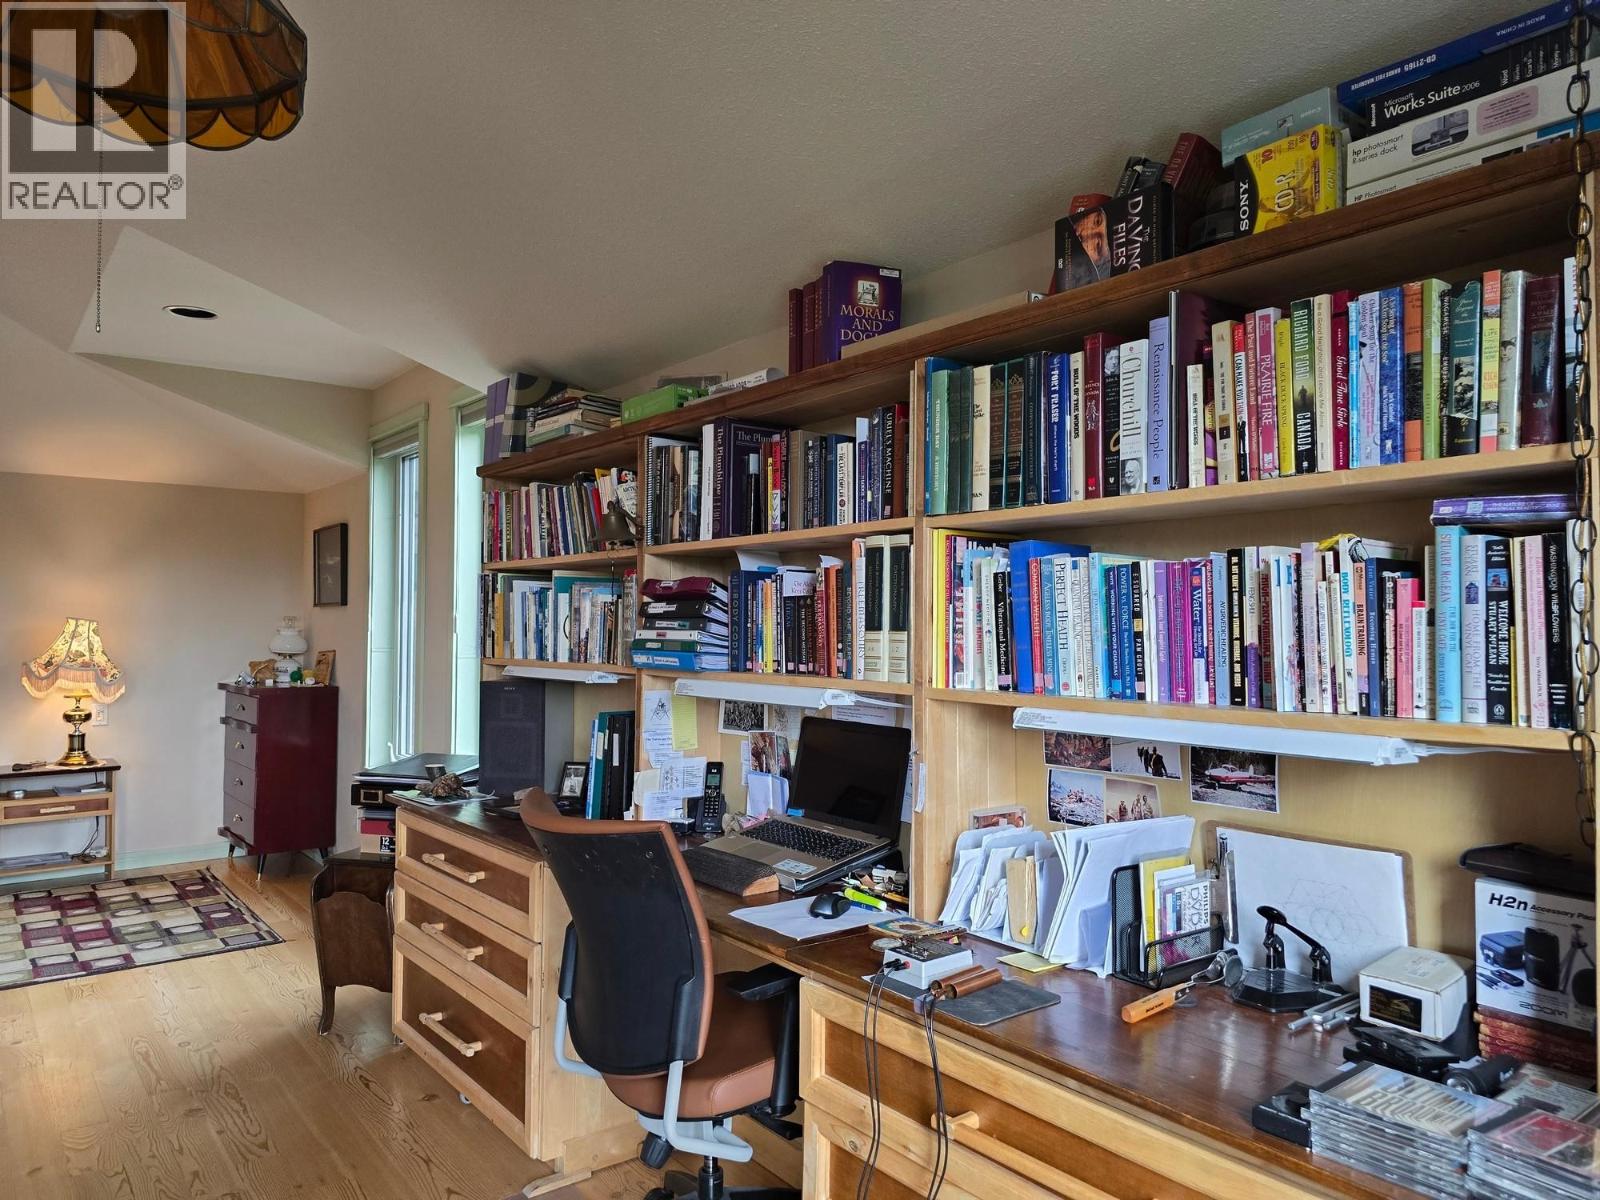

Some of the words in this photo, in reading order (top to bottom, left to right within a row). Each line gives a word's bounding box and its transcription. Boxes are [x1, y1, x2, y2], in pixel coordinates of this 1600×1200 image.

[1384, 92, 1414, 107] Microsoft
[1384, 99, 1425, 119] Works
[1427, 83, 1461, 105] Suite
[1462, 80, 1481, 93] 2006
[1380, 145, 1399, 157] dock
[1239, 179, 1250, 232] SONY
[1113, 222, 1127, 267] FILES
[840, 304, 896, 323] MORALS
[1360, 300, 1368, 323] Golden
[1368, 298, 1377, 324] Chicken
[1381, 297, 1389, 318] Chicken
[852, 318, 883, 333] AND
[1246, 319, 1254, 331] The
[1293, 308, 1310, 352] RICHARD
[1361, 324, 1369, 338] Soul
[1367, 324, 1376, 341] Soup
[1380, 318, 1389, 334] Soup
[1246, 333, 1255, 349] Past
[1234, 358, 1243, 371] CAN
[1248, 363, 1256, 388] Future
[1260, 354, 1272, 400] PRAIRIE
[1279, 362, 1287, 383] BLACK
[1294, 354, 1310, 381] FORD
[1336, 355, 1348, 379] Good
[1050, 370, 1060, 391] FORT
[1152, 342, 1165, 416] Renaissance
[1234, 371, 1244, 389] MAKE
[1073, 388, 1080, 397] OF
[1122, 357, 1142, 439] Churchill
[1235, 388, 1244, 402] YOU
[1248, 388, 1257, 405] Land
[1280, 384, 1288, 404] DUCK
[1318, 398, 1325, 410] Me
[1336, 381, 1348, 405] Time
[1050, 394, 1060, 424] FRASER
[1262, 402, 1273, 426] FIRE
[1280, 404, 1288, 428] SPRING
[1336, 406, 1349, 429] Girls
[716, 428, 724, 444] The
[736, 430, 750, 443] The
[1073, 412, 1081, 440] WOODS
[1296, 412, 1312, 452] CANADA
[1150, 418, 1164, 460] People
[716, 446, 724, 496] Plumbline
[885, 448, 893, 495] MACHINE
[1440, 534, 1452, 568] STUART
[1471, 544, 1480, 574] STUART
[1367, 565, 1376, 580] Jean
[1548, 544, 1558, 591] WASHINGTON
[1032, 562, 1040, 603] COMMON
[1054, 562, 1068, 607] PERFECT
[1120, 568, 1128, 595] POWER
[1341, 572, 1350, 595] BODY
[1368, 580, 1376, 601] Vanier
[1440, 570, 1452, 604] McLEAN
[1044, 582, 1053, 610] AGELESS
[1192, 588, 1203, 621] Water
[1248, 586, 1256, 603] FENG
[997, 602, 1006, 642] Vibrational
[1121, 605, 1129, 630] FORCE
[1219, 600, 1227, 638] AYURVEDIC
[1261, 576, 1271, 657] HIGH-PERFORMANCE
[1356, 604, 1365, 625] BRAIN
[1367, 611, 1377, 642] Becoming
[1438, 612, 1447, 633] VINYL
[1472, 609, 1481, 638] HOME
[1488, 600, 1498, 633] STUART
[1497, 600, 1509, 640] WELCOME
[1056, 610, 1069, 650] HEALTH
[1342, 599, 1353, 658] REFLEXOLOGY
[1357, 625, 1366, 656] TRAINING
[1449, 631, 1457, 642] FOR
[1464, 622, 1473, 650] VINYL
[1046, 629, 1054, 657] TIMELESS
[1220, 638, 1228, 669] HEALING
[1449, 643, 1457, 653] THE
[1472, 640, 1481, 670] FROM
[1488, 634, 1498, 665] McLEAN
[1498, 642, 1509, 665] HOME
[1263, 662, 1273, 684] MIND
[1473, 672, 1482, 690] THE
[382, 836, 390, 846] 12
[1488, 892, 1528, 911] H2n
[1530, 904, 1575, 918] Accessory
[1577, 912, 1596, 922] Pac
